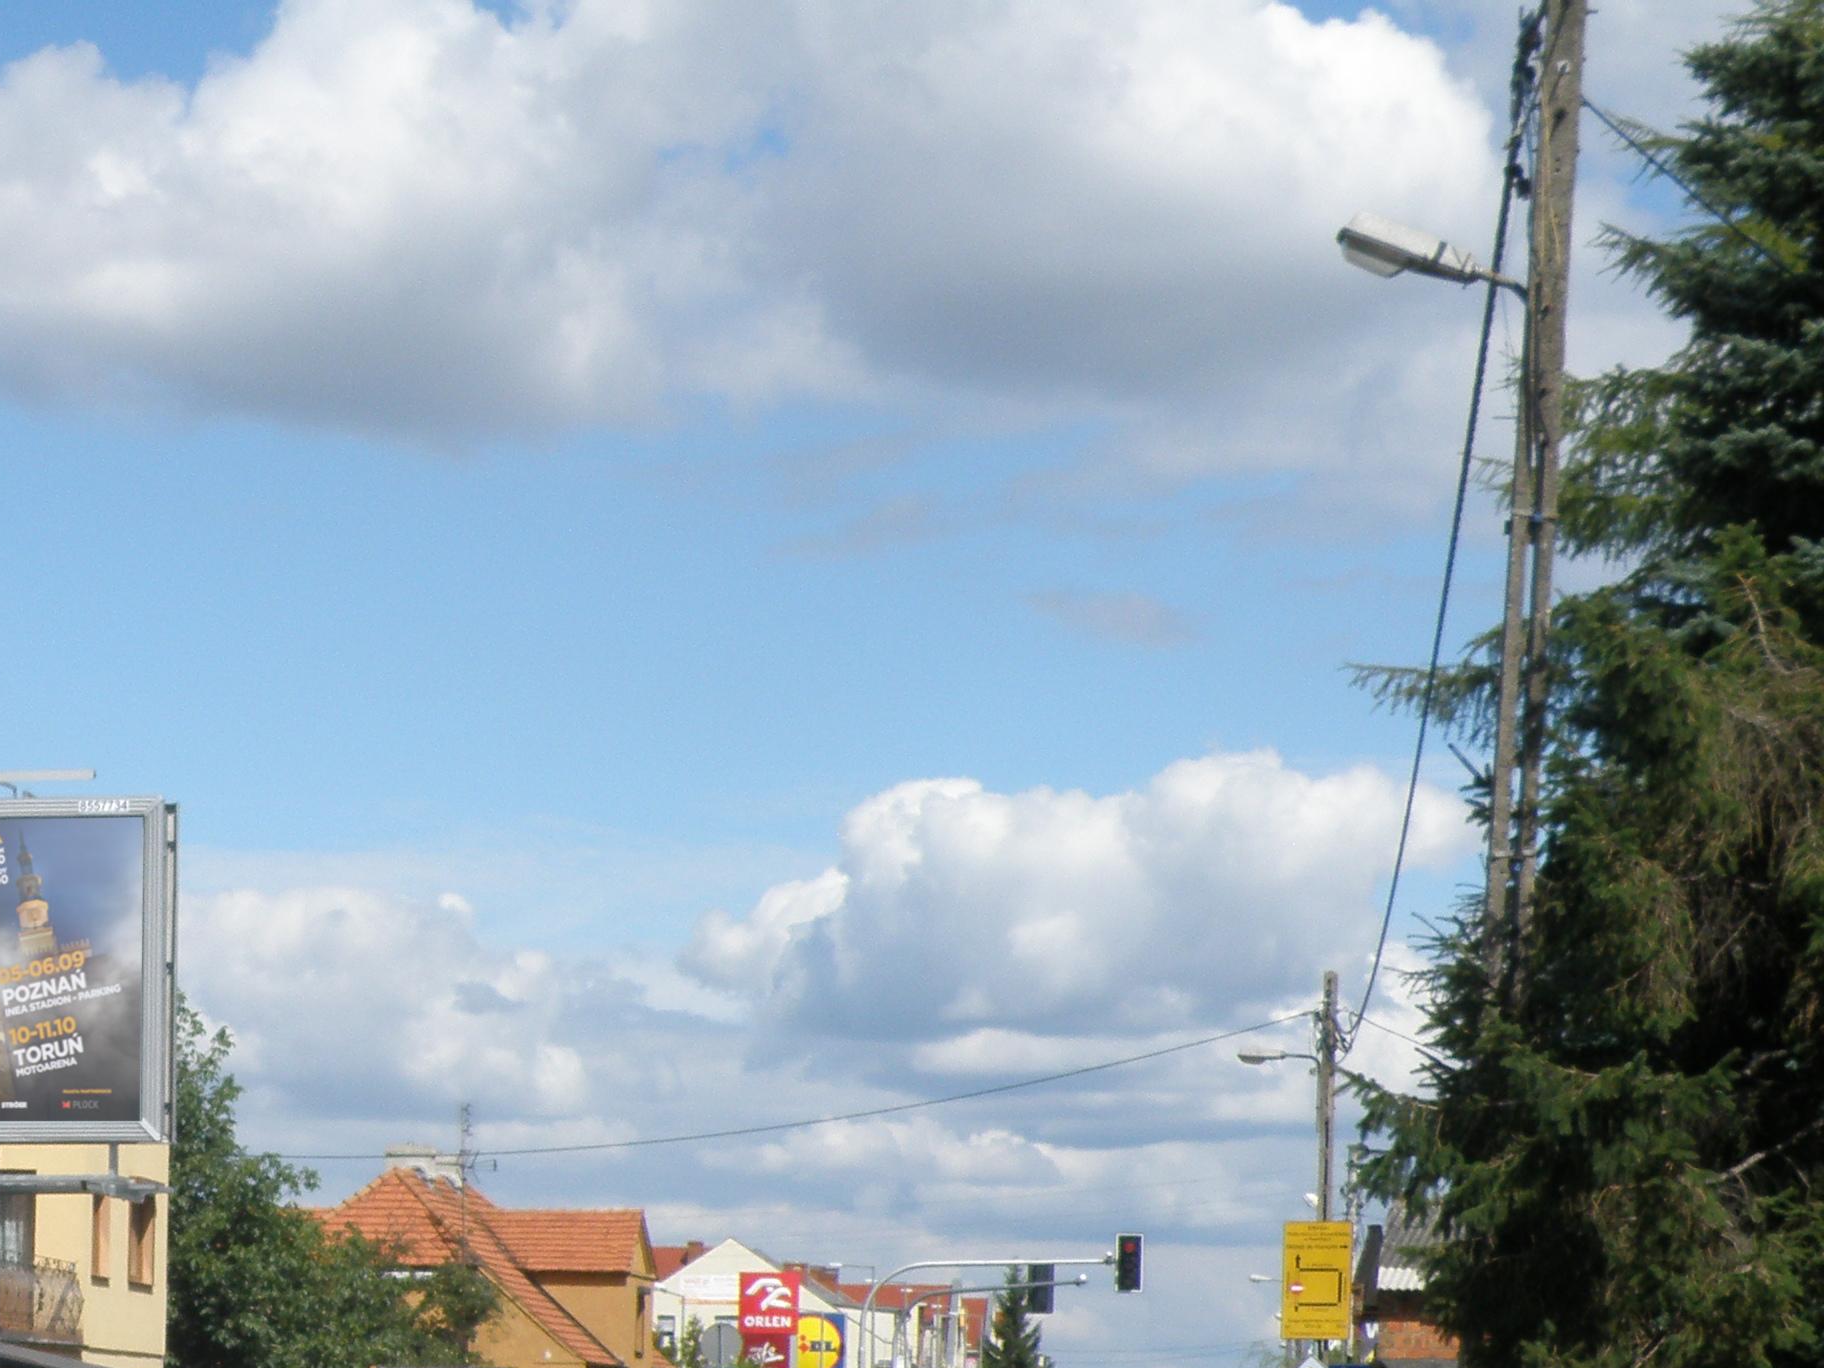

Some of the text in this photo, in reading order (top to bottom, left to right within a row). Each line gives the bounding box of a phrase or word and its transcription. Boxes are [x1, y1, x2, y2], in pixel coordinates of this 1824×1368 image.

[2, 968, 87, 1006] POZNAŃ
[5, 1004, 28, 1017] INEA
[29, 995, 72, 1012] STADION
[78, 984, 122, 1001] PARKING
[9, 1016, 77, 1045] 10-11.10
[12, 1033, 85, 1066] TORUŃ
[15, 1057, 78, 1078] MOTOARENA
[744, 1316, 792, 1328] ORLEN
